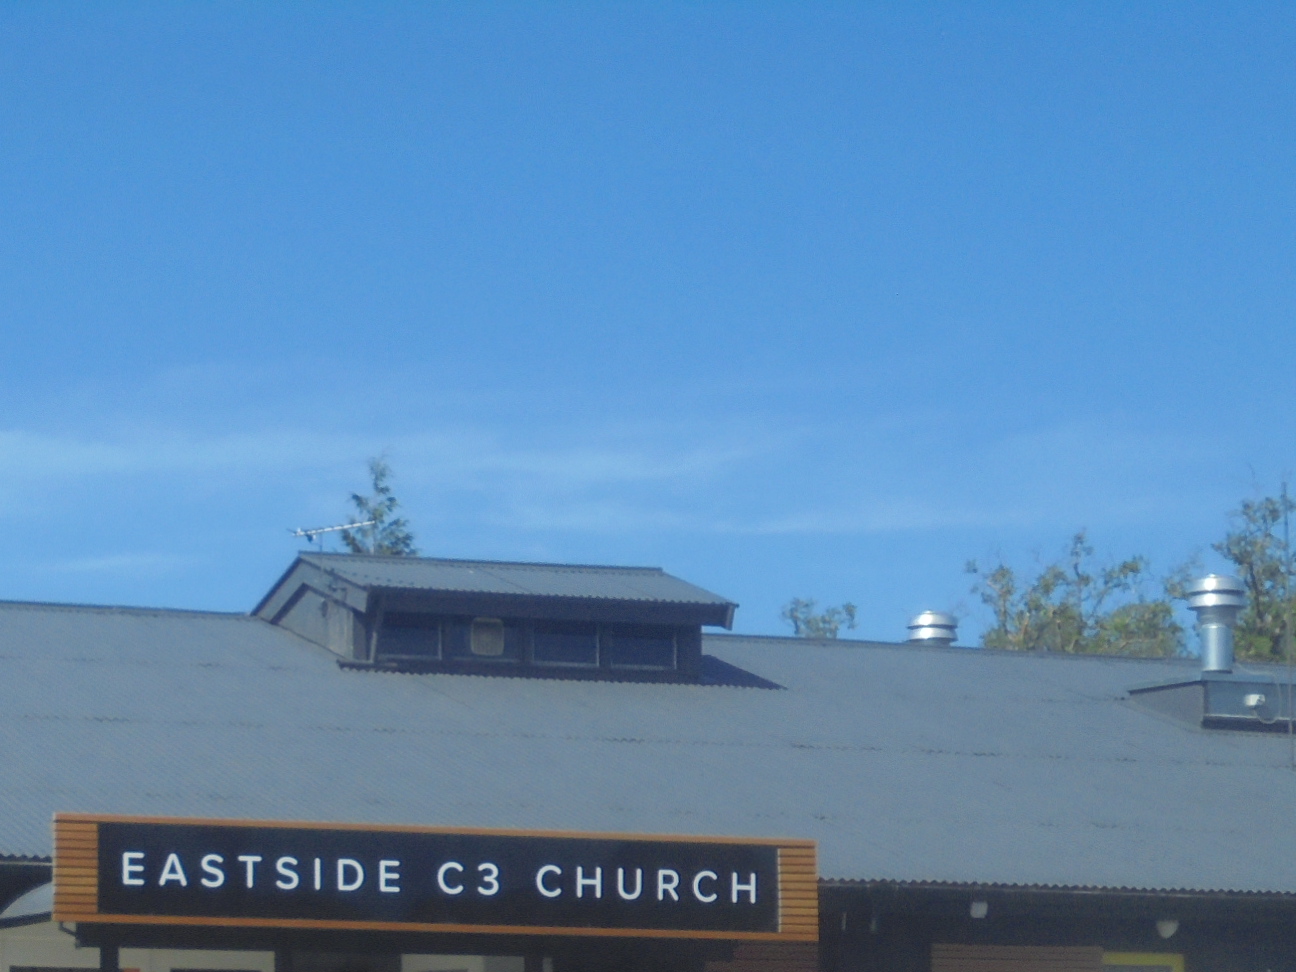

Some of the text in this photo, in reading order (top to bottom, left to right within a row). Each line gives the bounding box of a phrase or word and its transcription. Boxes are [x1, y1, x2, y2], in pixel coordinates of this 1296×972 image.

[121, 851, 758, 905] EASTSIDE C3 CHURCH
